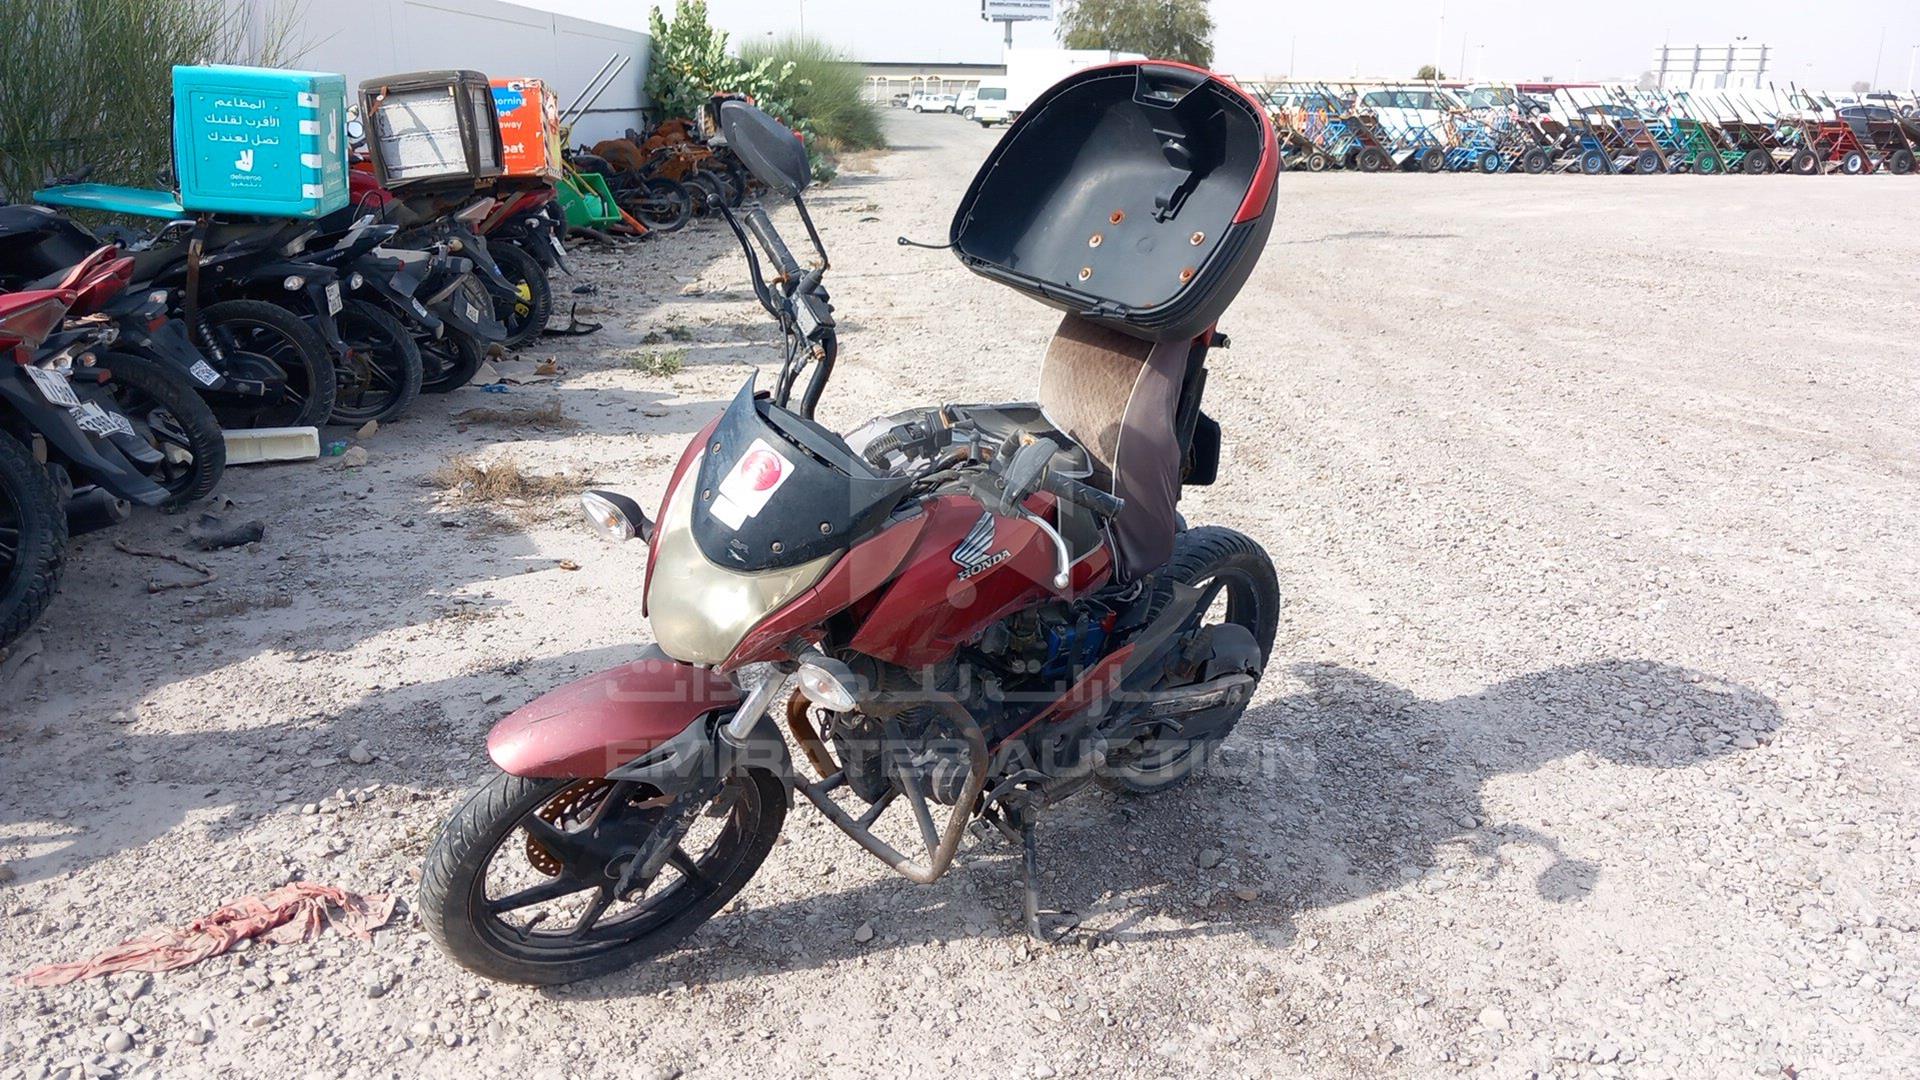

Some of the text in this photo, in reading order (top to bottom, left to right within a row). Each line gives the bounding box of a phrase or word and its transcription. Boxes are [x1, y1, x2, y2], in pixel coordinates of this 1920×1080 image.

[214, 97, 266, 110] المطاعم
[245, 115, 280, 129] الأقرب
[251, 133, 279, 147] تصل
[957, 549, 1012, 582] HONDA
